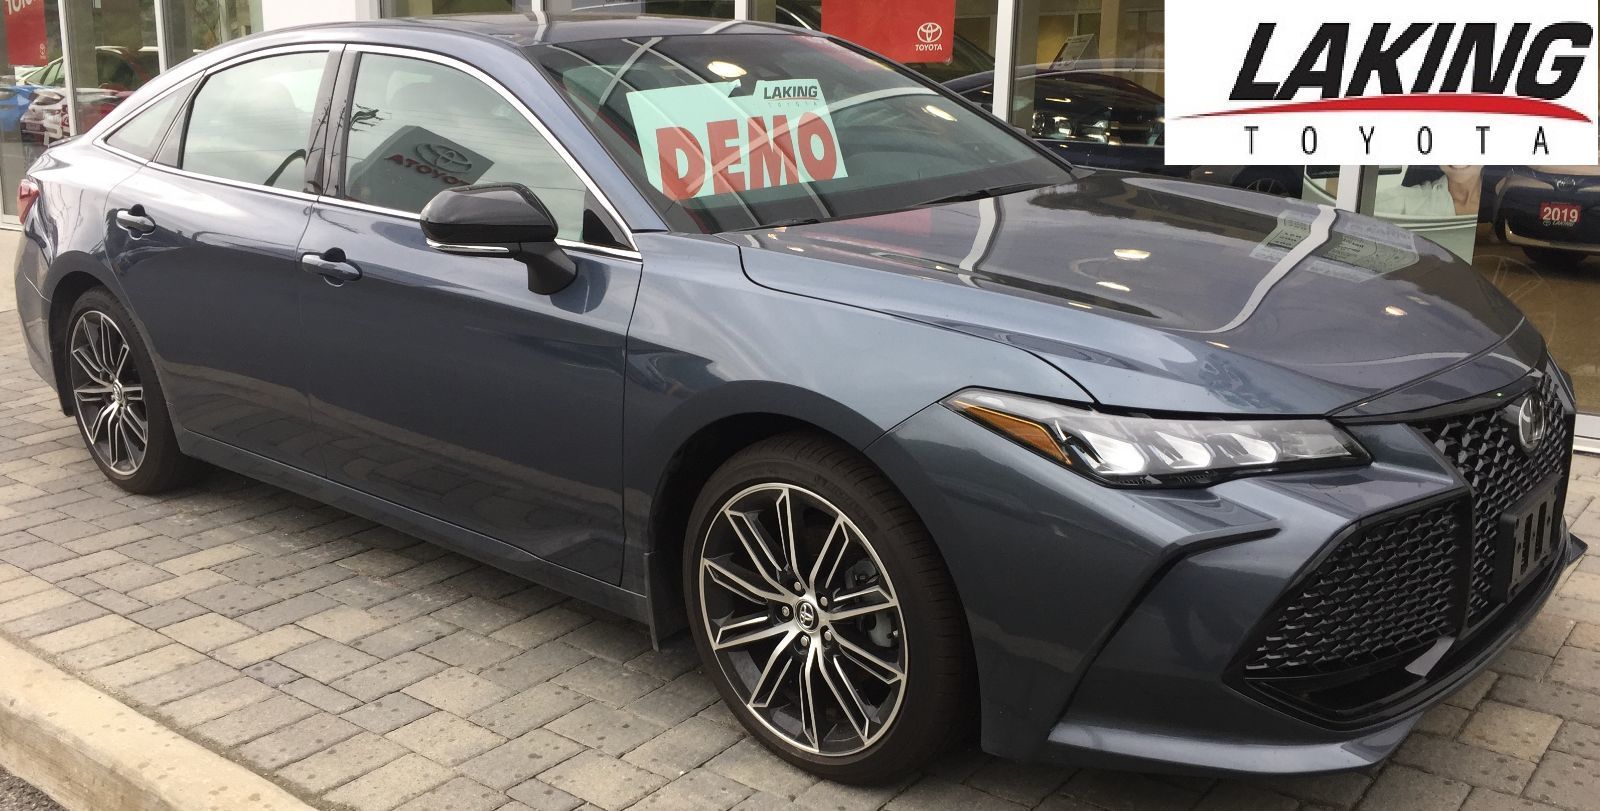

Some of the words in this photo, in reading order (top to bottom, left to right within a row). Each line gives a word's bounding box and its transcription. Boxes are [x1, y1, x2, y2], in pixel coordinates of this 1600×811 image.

[763, 86, 818, 99] LAKING
[656, 112, 837, 199] DEMO
[1543, 206, 1579, 222] 2019
